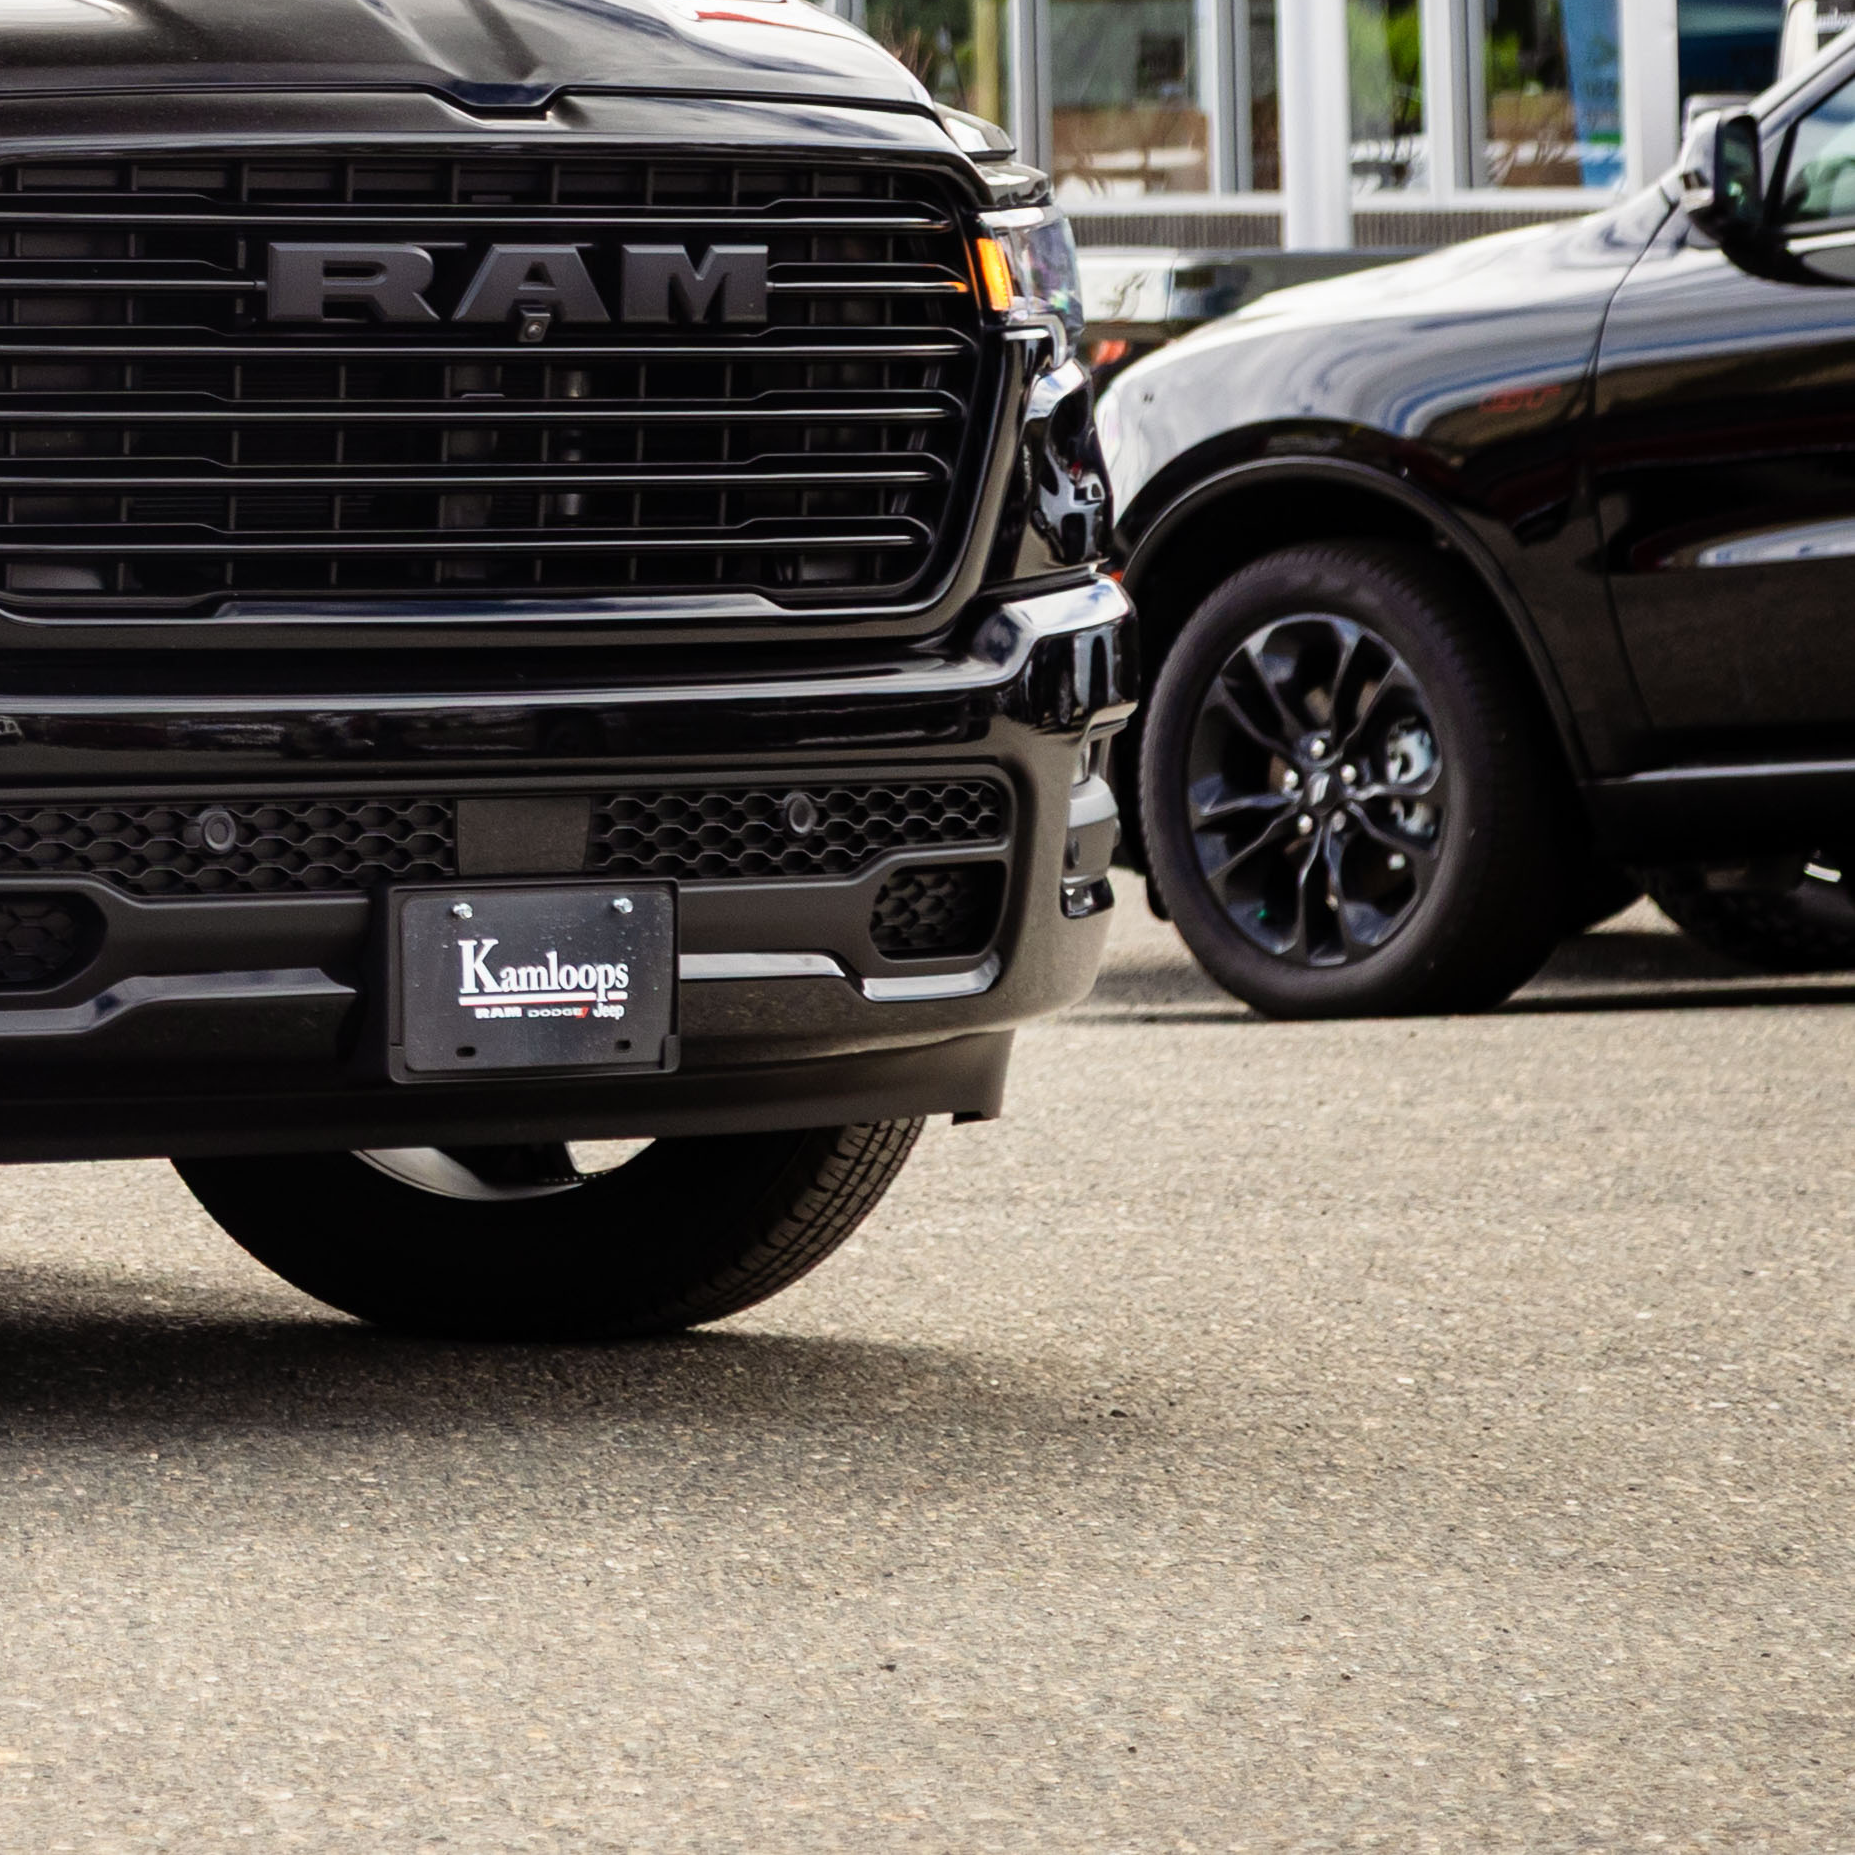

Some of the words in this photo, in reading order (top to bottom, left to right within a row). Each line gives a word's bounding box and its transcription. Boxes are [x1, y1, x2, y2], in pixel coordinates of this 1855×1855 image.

[267, 242, 768, 323] RAM
[457, 938, 630, 1003] Kamloops
[474, 1005, 523, 1020] RAM
[526, 1007, 583, 1018] DODGE
[592, 1001, 625, 1020] Jeep
